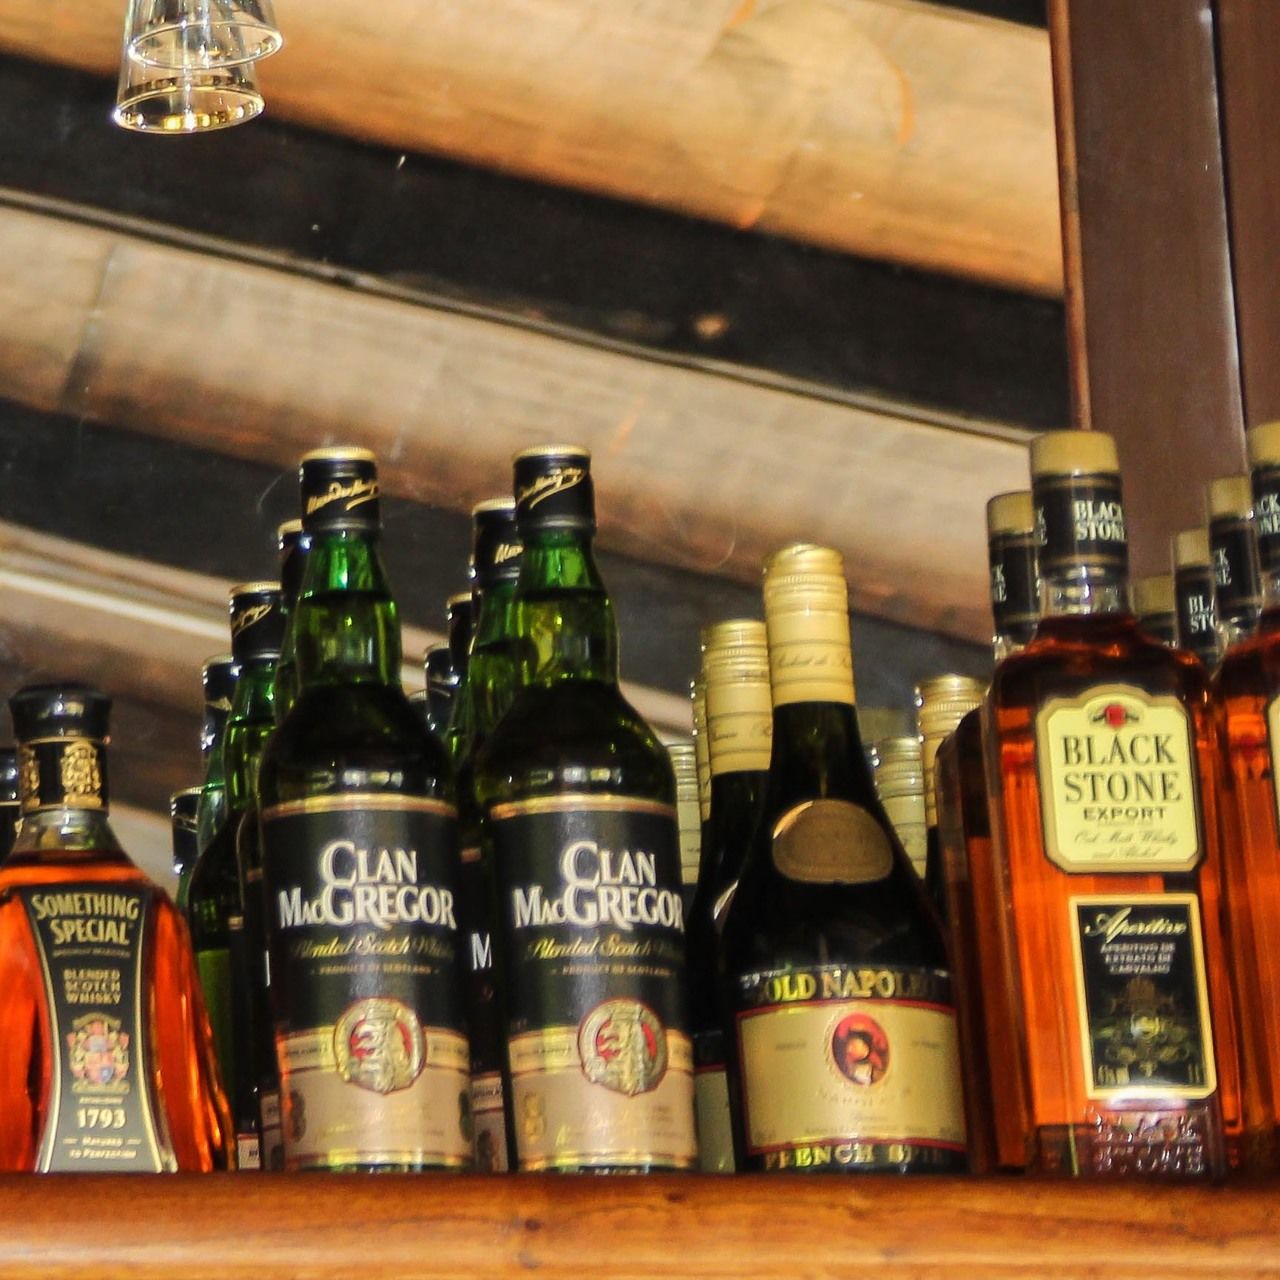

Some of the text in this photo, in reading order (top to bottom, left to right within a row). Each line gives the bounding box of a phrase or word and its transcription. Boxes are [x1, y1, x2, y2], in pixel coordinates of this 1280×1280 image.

[1062, 734, 1177, 766] BLACK
[1064, 770, 1182, 803] STONE
[1083, 806, 1167, 821] EXPORT
[320, 840, 418, 885] CLAN
[561, 840, 657, 887] CLAN
[31, 892, 139, 920] SOMETHING
[50, 919, 130, 945] SPECIAL
[356, 933, 411, 957] Scotch
[601, 933, 652, 957] Scotch
[64, 969, 120, 980] BLENDED
[65, 981, 121, 992] SCOTCH
[66, 992, 121, 1004] WHISKY
[77, 1108, 127, 1128] 1793
[765, 1144, 873, 1170] FRENCH
